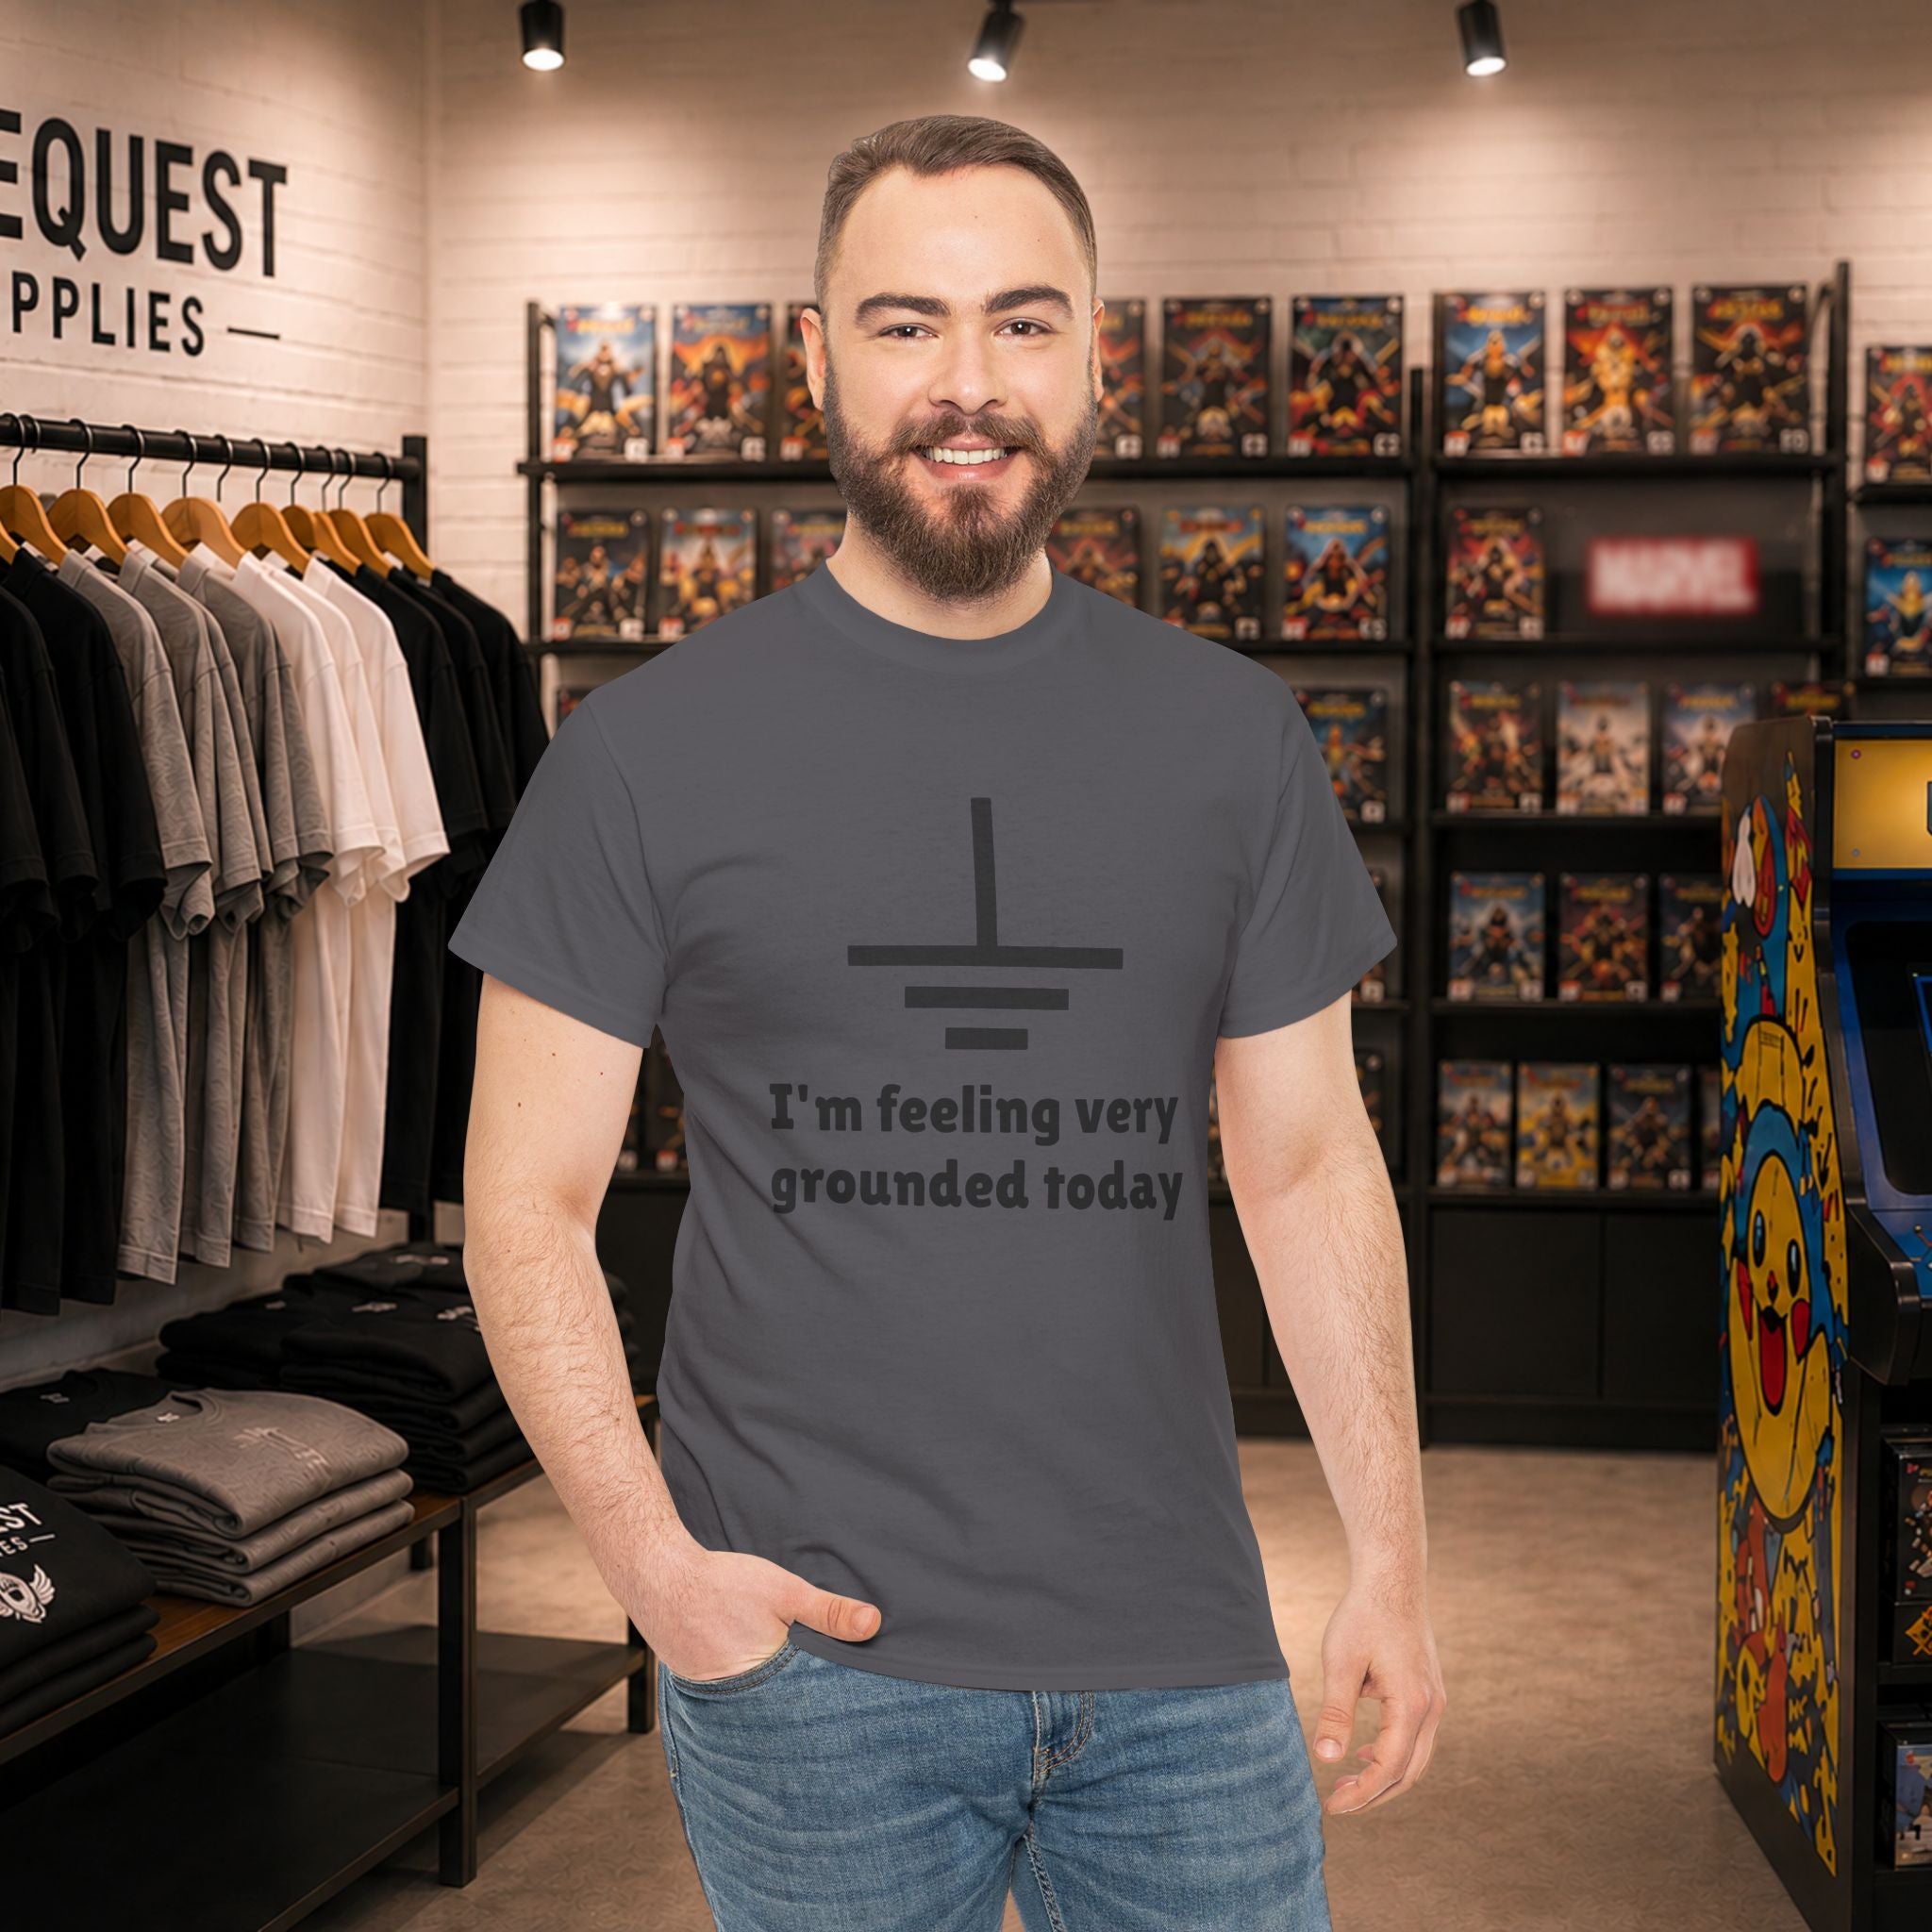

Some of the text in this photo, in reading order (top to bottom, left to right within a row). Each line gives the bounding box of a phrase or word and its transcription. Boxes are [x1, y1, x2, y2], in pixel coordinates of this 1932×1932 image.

[11, 270, 205, 357] PPLIES
[770, 1083, 1179, 1146] I'm feeling very
[771, 1159, 1184, 1221] grounded today
[0, 1503, 42, 1533] ST
[0, 1536, 28, 1556] ES
